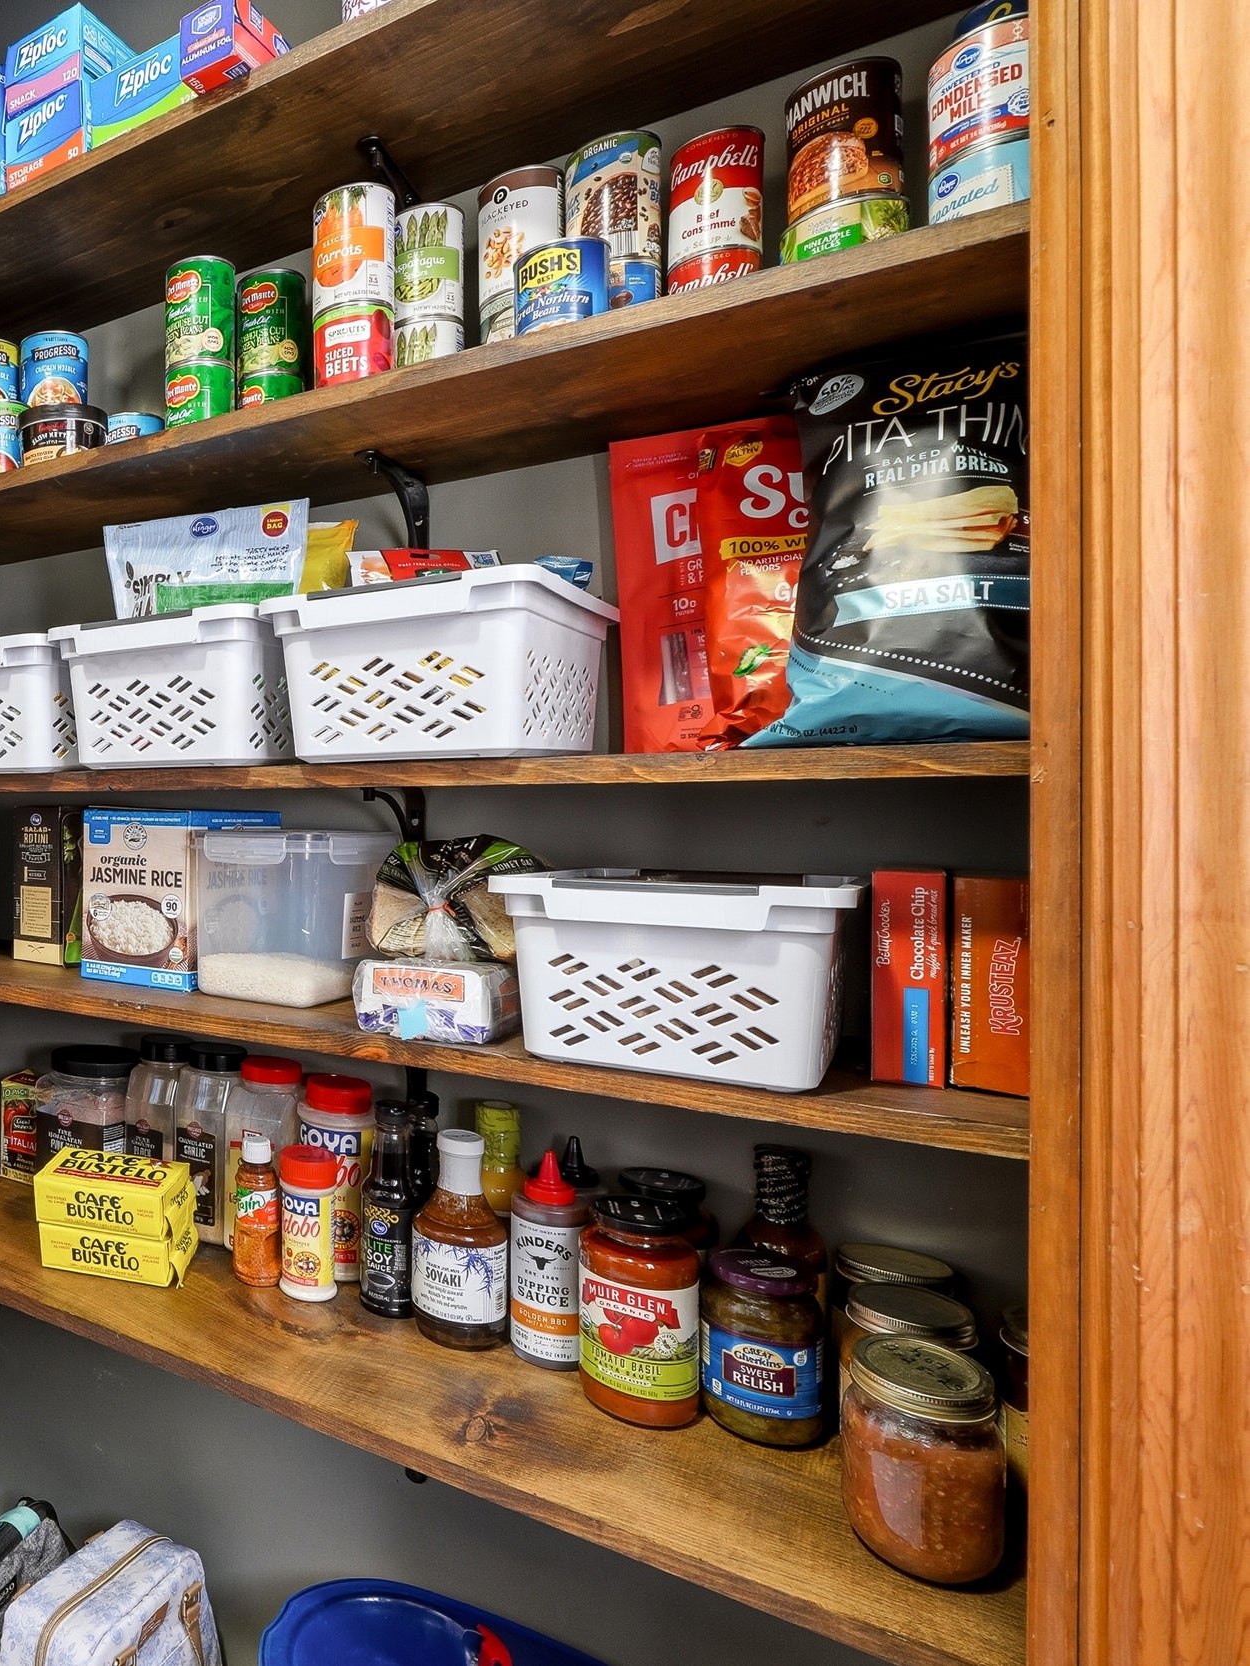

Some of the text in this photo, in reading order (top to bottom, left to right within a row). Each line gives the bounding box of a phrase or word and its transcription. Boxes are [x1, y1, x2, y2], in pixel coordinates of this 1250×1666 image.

[19, 28, 68, 70] Ziploc
[62, 67, 78, 82] 120
[118, 55, 172, 98] Ziploc
[941, 62, 1000, 95] SWEETED
[10, 89, 36, 110] SNACK
[931, 63, 1023, 122] CONDENSED
[18, 94, 68, 145] Ziploc
[792, 102, 849, 139] ORIGINAL
[67, 147, 78, 160] 50
[584, 139, 618, 159] ORGANIC
[9, 158, 44, 182] STORAGE
[671, 143, 759, 191] Campbell's
[322, 233, 353, 249] SLICED
[316, 246, 363, 268] Carrots
[395, 255, 446, 275] sparagus
[520, 251, 578, 287] BUSH'S
[537, 292, 590, 309] Northern
[193, 315, 209, 325] CUT
[532, 305, 560, 320] Beans
[270, 325, 286, 336] CUT
[34, 345, 77, 361] PROGRESSO
[325, 346, 354, 363] SLICED
[325, 356, 369, 379] BEETS
[872, 361, 1021, 416] Stacy's
[822, 416, 917, 475] PITA
[882, 449, 941, 467] BAKED
[865, 455, 1009, 489] REAL PITA BREAD
[729, 540, 780, 554] 100%
[740, 553, 803, 568] NO ARTIFICIAL
[740, 563, 781, 576] FLAVORS
[884, 581, 995, 610] SEA SALT
[100, 854, 147, 868] organic
[492, 859, 520, 873] HONEY
[90, 867, 183, 888] JASMINE RICE
[165, 901, 179, 912] 90
[910, 886, 929, 980] Chocolate Chip
[959, 915, 972, 1054] UNLEASH YOUR INNER MAKER
[988, 939, 1022, 1036] KRUSTEAZ
[300, 1124, 358, 1156] GOYA
[183, 1144, 207, 1159] GARLIC
[59, 1158, 167, 1182] BUSTELO
[66, 1202, 135, 1227] BUSTELO
[367, 1238, 392, 1254] LITE
[515, 1235, 572, 1261] KINDER'S
[71, 1248, 140, 1272] BUSTELO
[367, 1249, 393, 1266] SOY
[367, 1260, 392, 1274] SAUCE
[425, 1266, 462, 1288] SOYAKI
[517, 1275, 570, 1297] DIPPING
[517, 1285, 569, 1308] SAUCE
[589, 1283, 665, 1315] MUIR GLEN
[519, 1307, 567, 1327] GOLDEN BBQ
[598, 1299, 651, 1320] ORGANIC
[591, 1345, 662, 1376] TOMATO BASIL
[734, 1350, 782, 1369] Gherkins
[742, 1346, 774, 1360] GREAT
[732, 1370, 784, 1394] RELISH
[740, 1364, 776, 1381] SWEET
